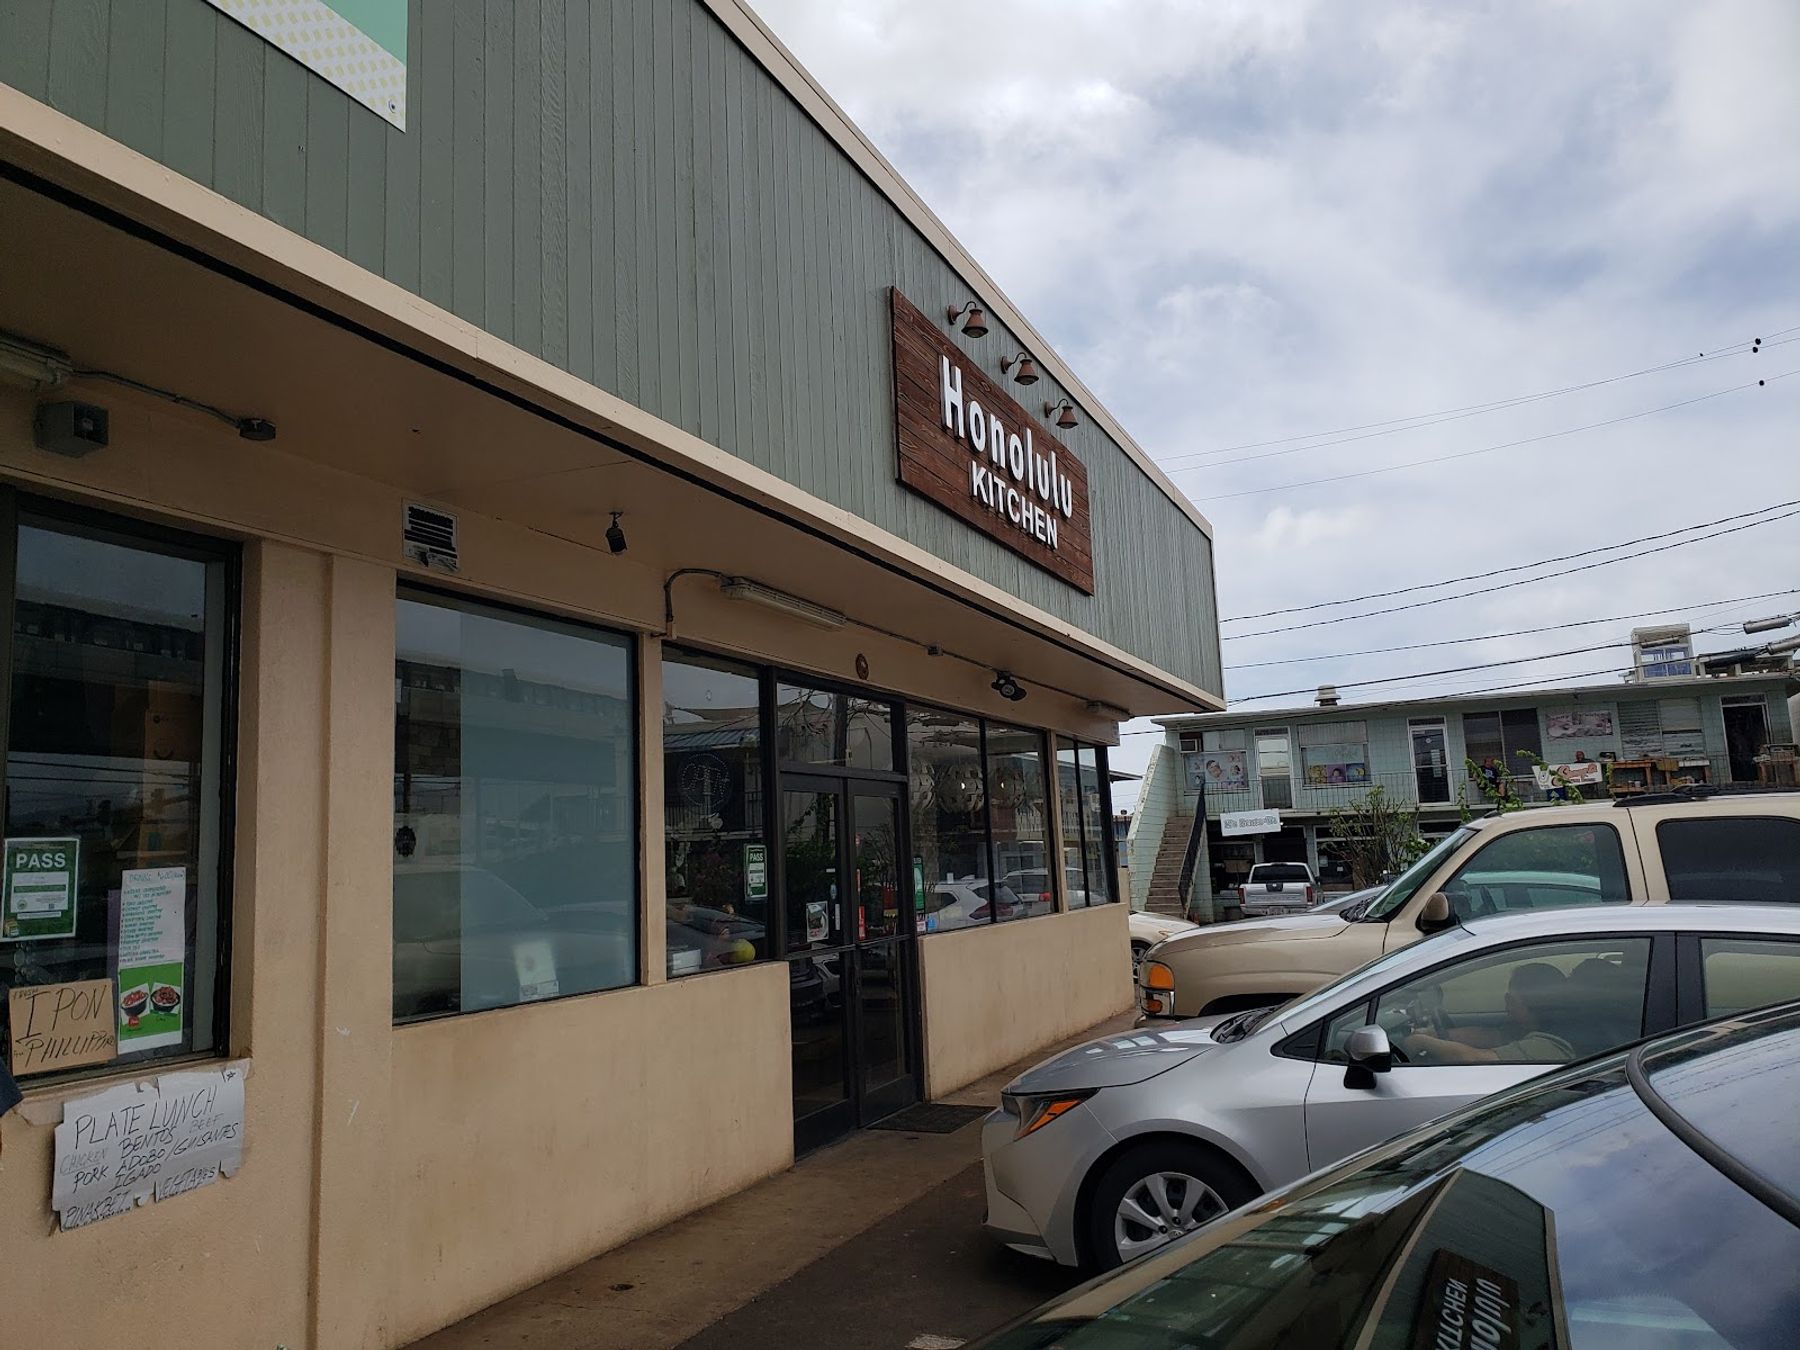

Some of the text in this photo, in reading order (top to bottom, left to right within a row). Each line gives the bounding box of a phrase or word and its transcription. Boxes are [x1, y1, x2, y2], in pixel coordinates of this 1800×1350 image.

[939, 354, 1074, 519] Honolulu
[969, 460, 1060, 550] KITCHEN
[15, 852, 67, 869] PASS
[749, 852, 764, 862] PASS
[75, 1084, 218, 1150] PLATE LUNCH
[119, 1127, 177, 1159] BENTOS
[73, 1165, 109, 1193] PORK
[109, 1163, 162, 1192] IGADO
